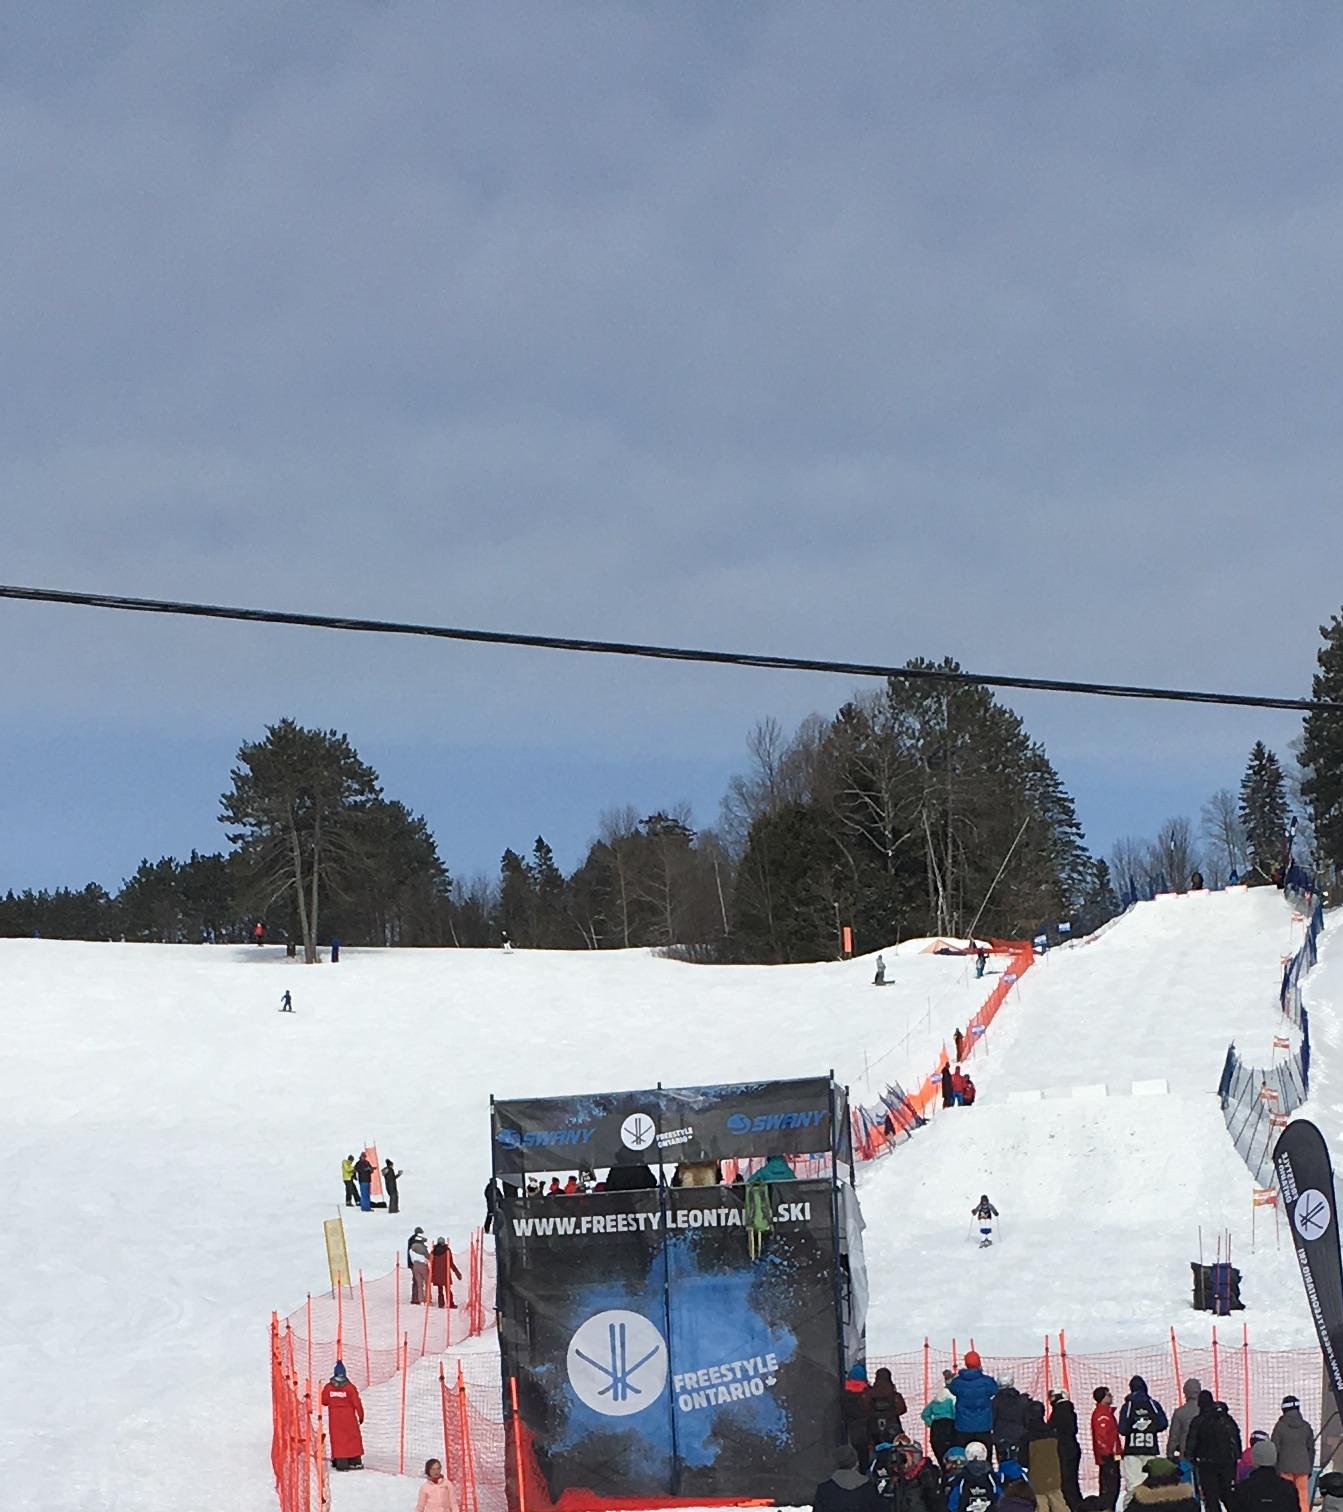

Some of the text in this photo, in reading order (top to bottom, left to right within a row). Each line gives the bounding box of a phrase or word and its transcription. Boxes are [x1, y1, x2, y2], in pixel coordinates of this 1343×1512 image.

[752, 1110, 829, 1132] SWANY
[522, 1128, 595, 1147] SWANY
[513, 1202, 811, 1237] WWW.FREESTYLEONTA.SKI
[673, 1353, 779, 1393] FREESTYLE
[678, 1377, 764, 1412] ONTARIO
[1129, 1432, 1154, 1447] 129
